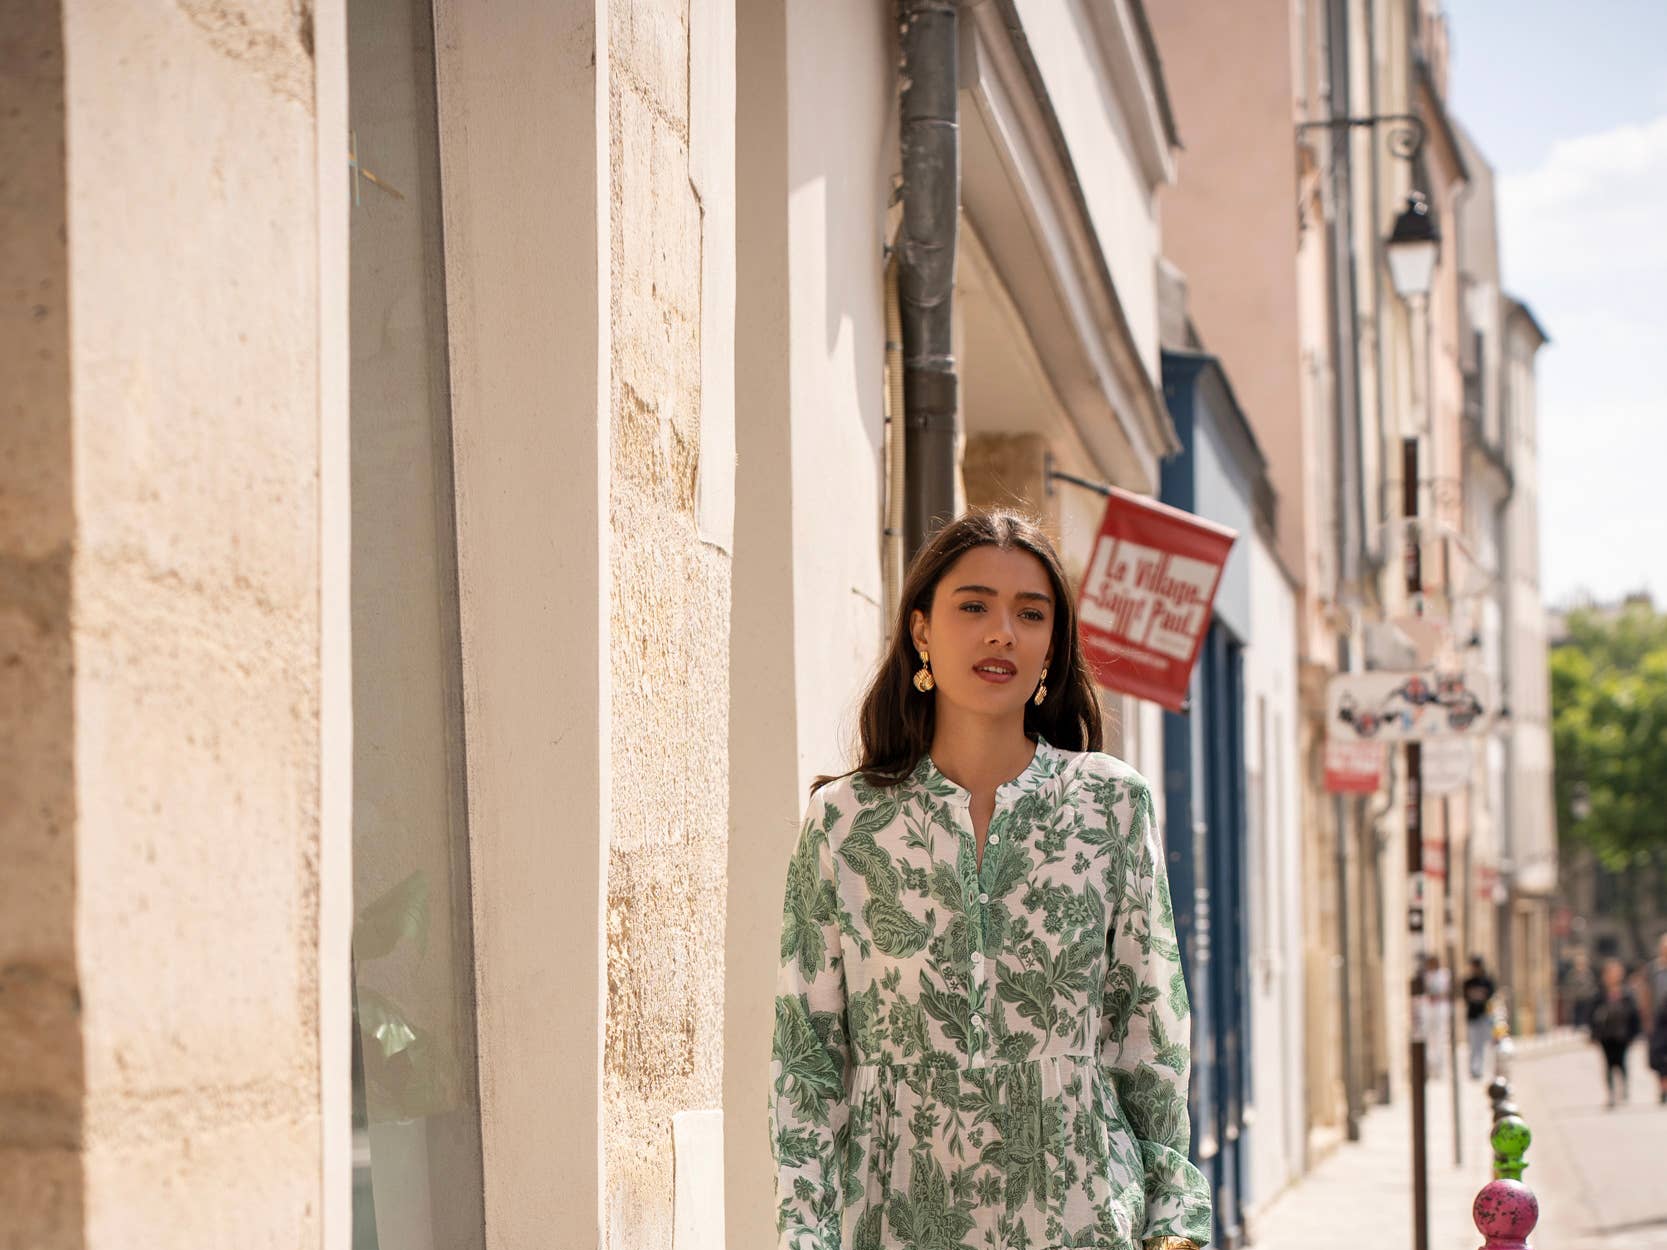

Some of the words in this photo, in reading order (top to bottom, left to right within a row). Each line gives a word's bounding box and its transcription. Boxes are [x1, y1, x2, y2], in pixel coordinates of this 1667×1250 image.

[1105, 540, 1127, 581] Le
[1135, 552, 1203, 606] Village
[1091, 581, 1147, 634] Saint
[1143, 600, 1196, 644] Paul
